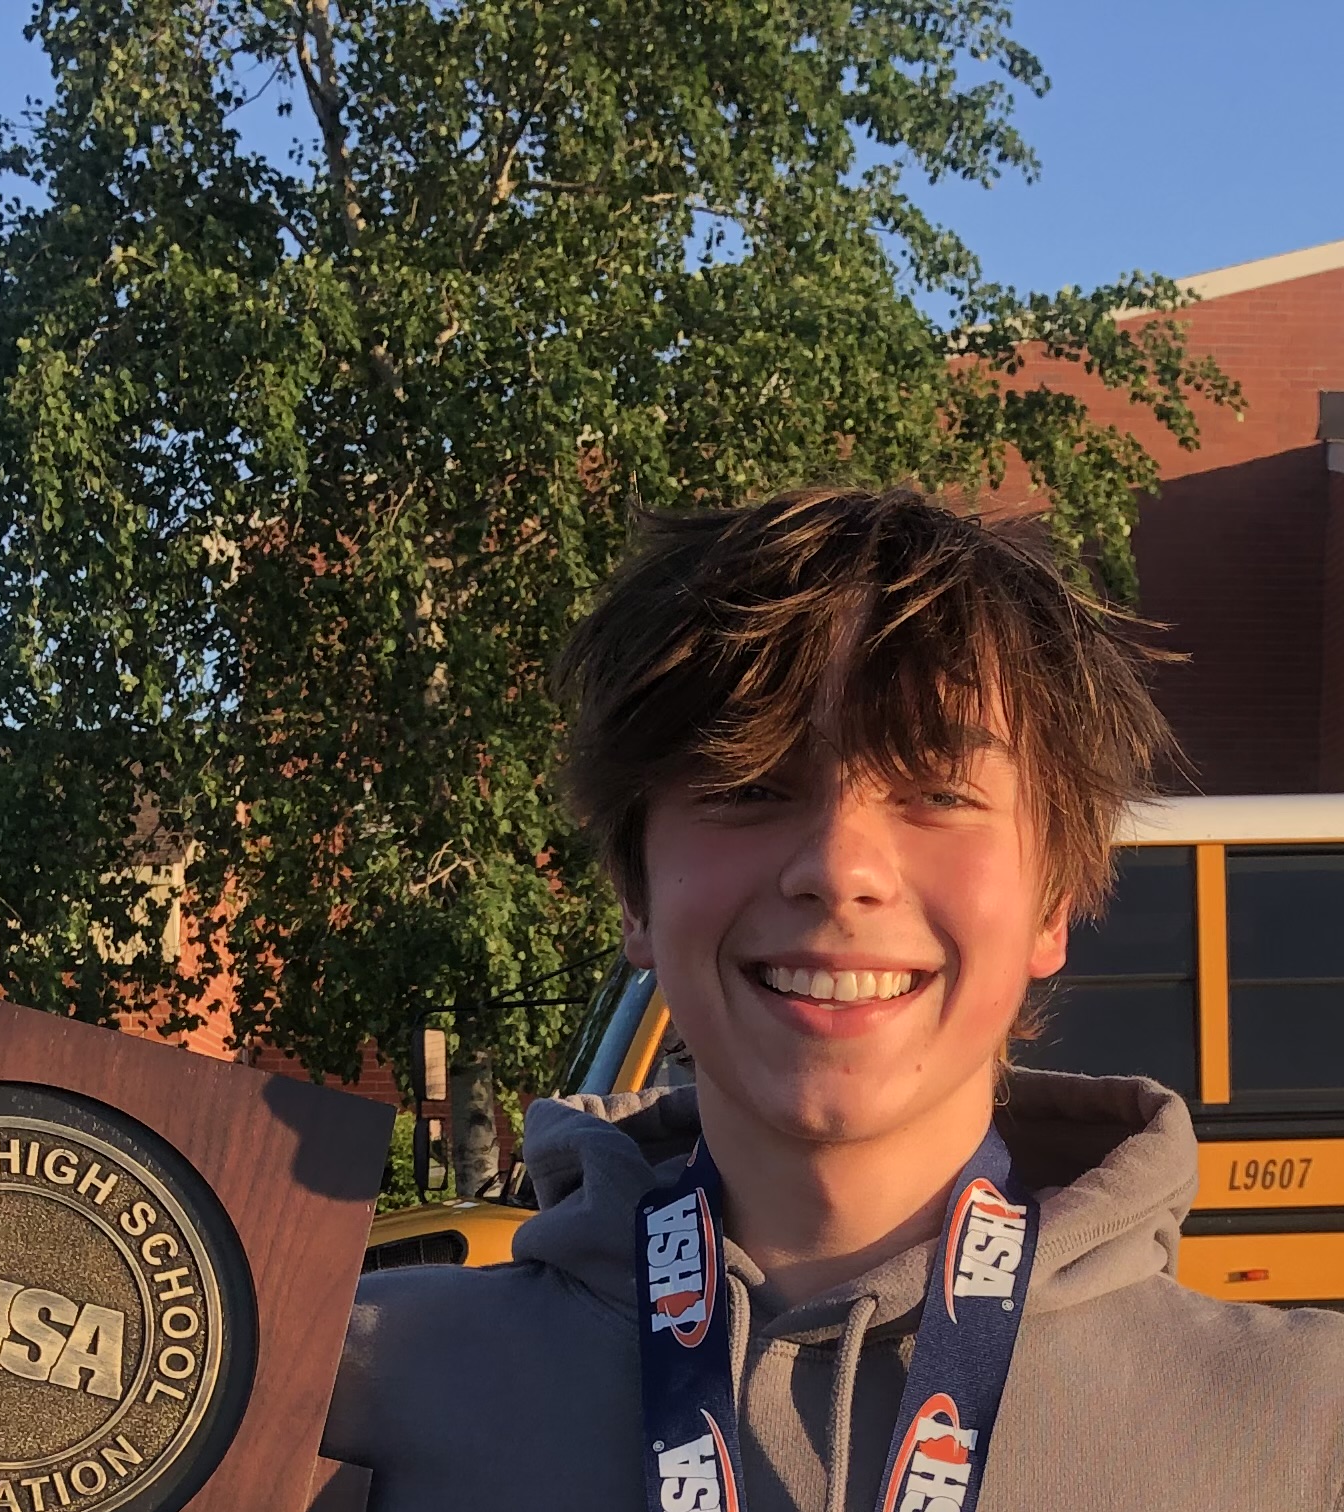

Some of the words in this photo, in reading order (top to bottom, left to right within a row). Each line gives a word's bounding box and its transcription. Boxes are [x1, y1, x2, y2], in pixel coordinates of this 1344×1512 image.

[1229, 1158, 1313, 1191] L9607
[119, 1200, 200, 1405] SCHOOL
[646, 1191, 708, 1333] IHSA
